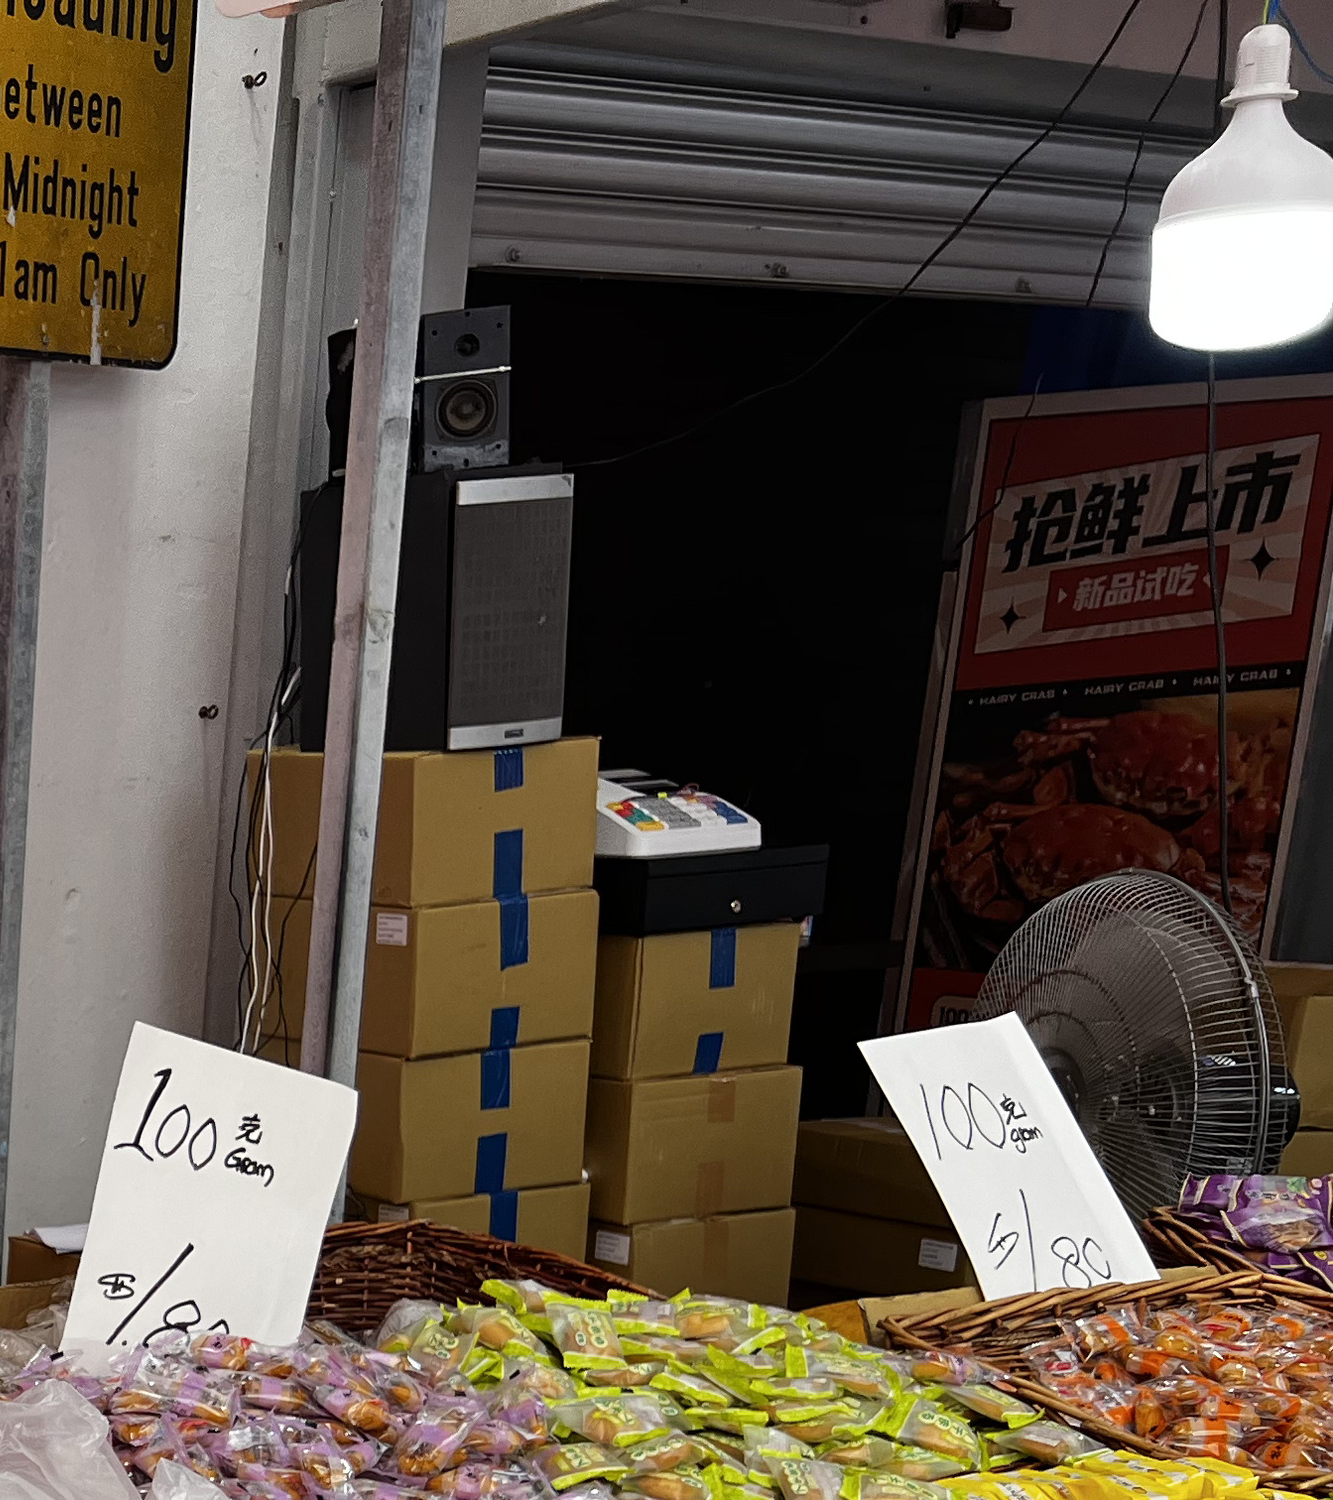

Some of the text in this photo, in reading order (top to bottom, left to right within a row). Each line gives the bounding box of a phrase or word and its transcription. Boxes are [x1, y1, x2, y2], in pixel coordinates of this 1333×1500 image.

[2, 153, 140, 240] Midnight
[79, 255, 147, 327] Only
[1002, 449, 1301, 575] 抢鲜上市
[1072, 560, 1200, 613] 新品试吃
[1021, 688, 1056, 703] CRAB
[1084, 682, 1125, 697] HAIRY
[1128, 678, 1166, 693] CRAB
[1239, 669, 1279, 684] CRAB
[114, 1068, 218, 1171] 100
[919, 1082, 1007, 1161] 100
[987, 1187, 1113, 1293] $180
